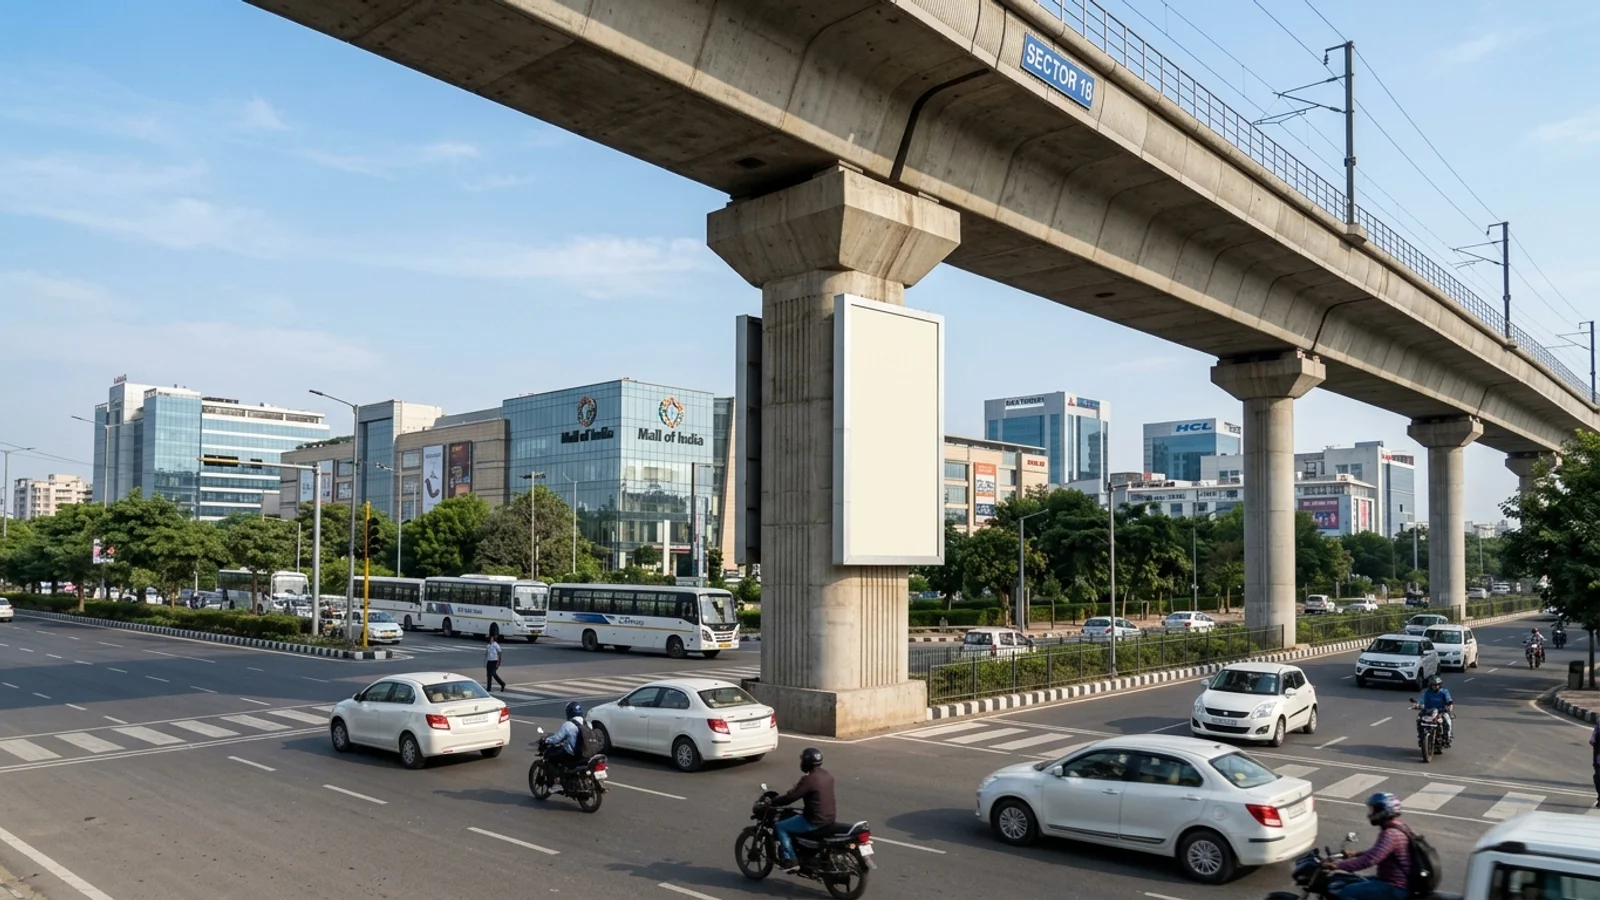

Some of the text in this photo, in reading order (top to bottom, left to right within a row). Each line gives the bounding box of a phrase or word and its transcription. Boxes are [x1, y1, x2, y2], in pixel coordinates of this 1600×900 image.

[1026, 43, 1093, 101] SECTOR 18
[638, 427, 704, 446] Mall of India
[1175, 422, 1212, 432] HCL
